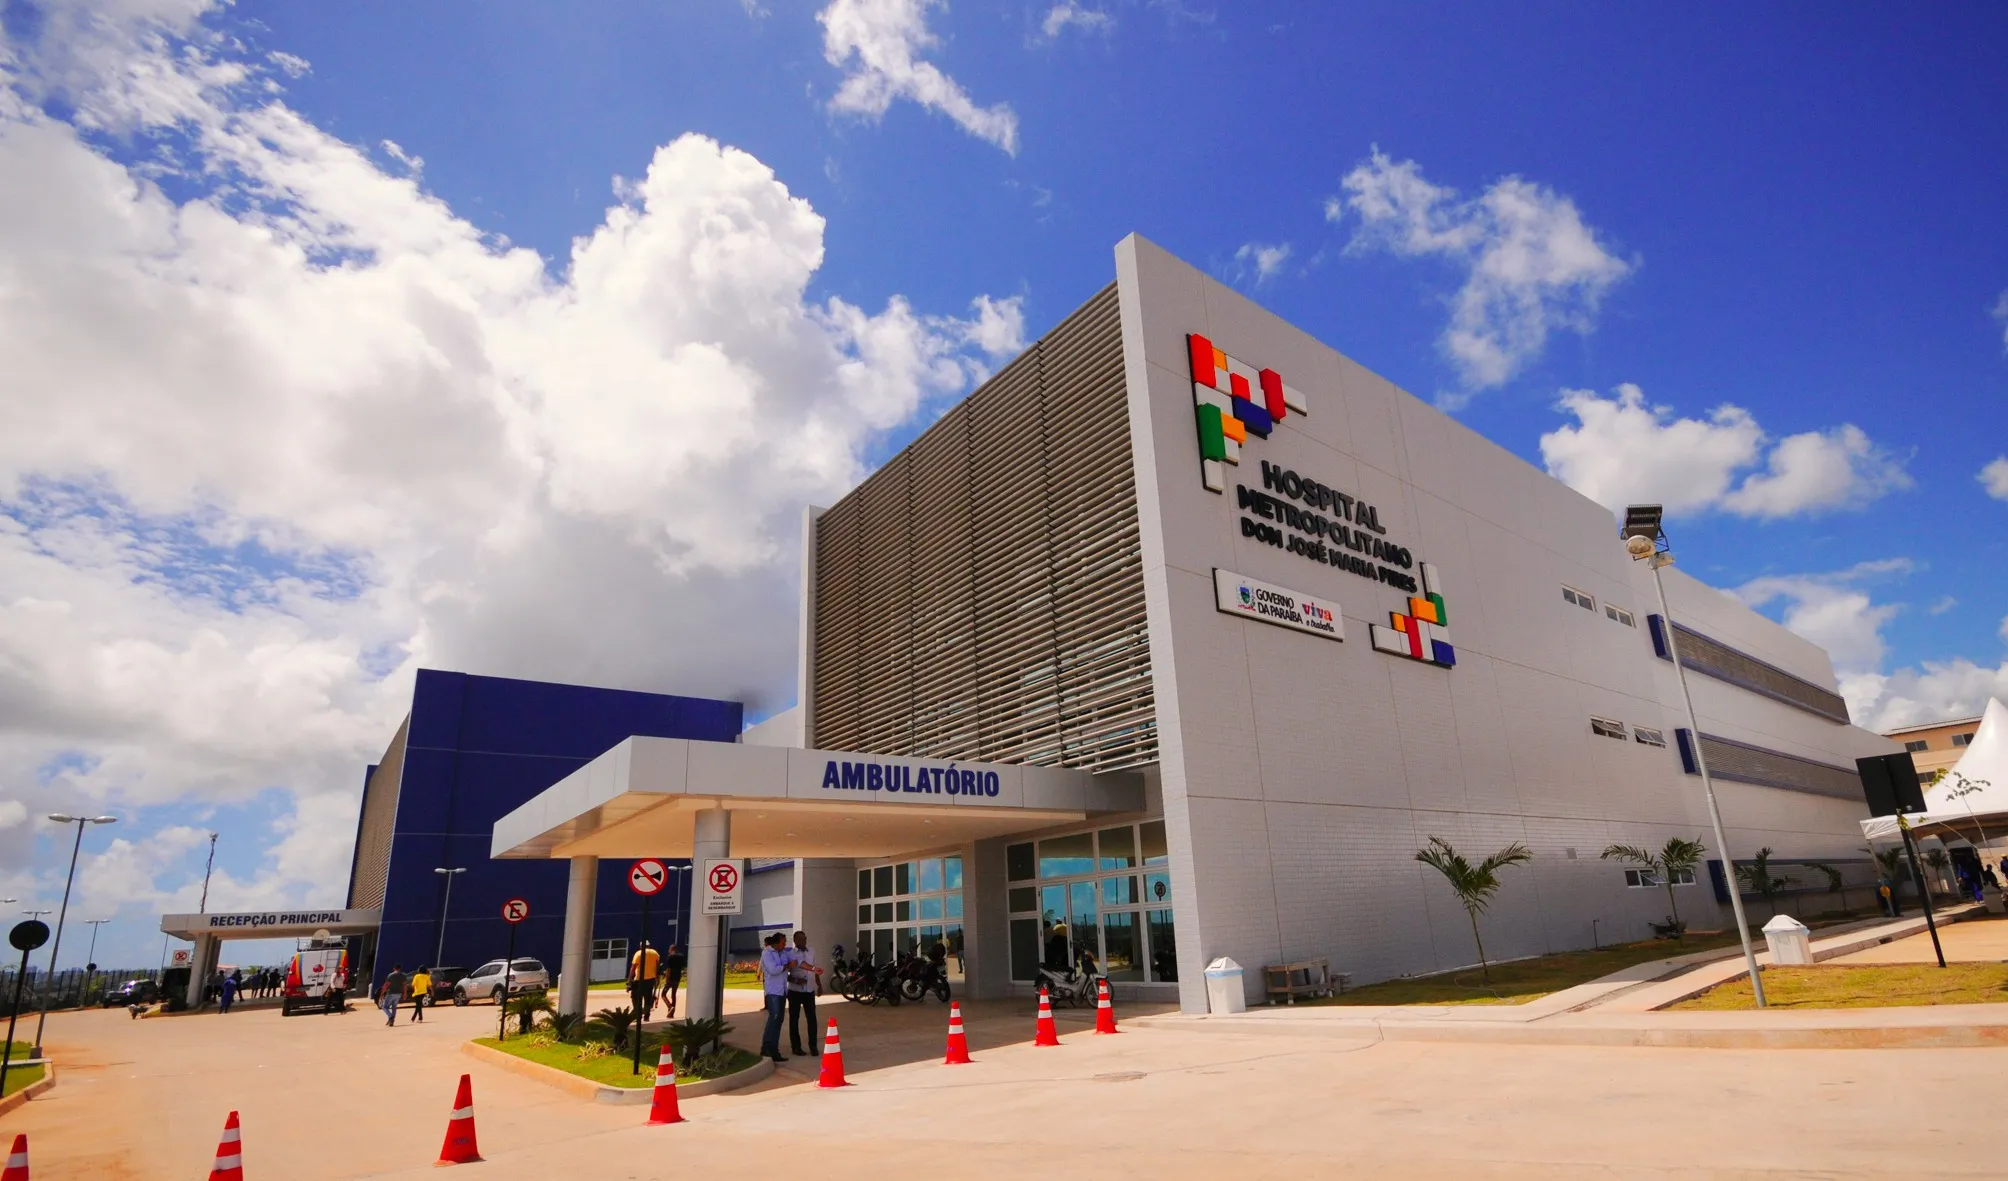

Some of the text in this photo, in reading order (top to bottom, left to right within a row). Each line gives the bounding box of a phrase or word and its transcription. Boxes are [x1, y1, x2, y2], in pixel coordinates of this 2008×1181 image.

[1261, 460, 1386, 534] HOSPITAL
[1236, 484, 1412, 569] METROPOLITANO
[1240, 516, 1417, 593] DOM JOSÉ MARIA PIRES
[1256, 588, 1294, 609] GOVERNO
[1257, 602, 1270, 616] DA
[1301, 601, 1333, 621] viva
[822, 761, 999, 797] AMBULATÓRIO
[210, 912, 342, 928] RECEPÇÃO PRINCIPAL
